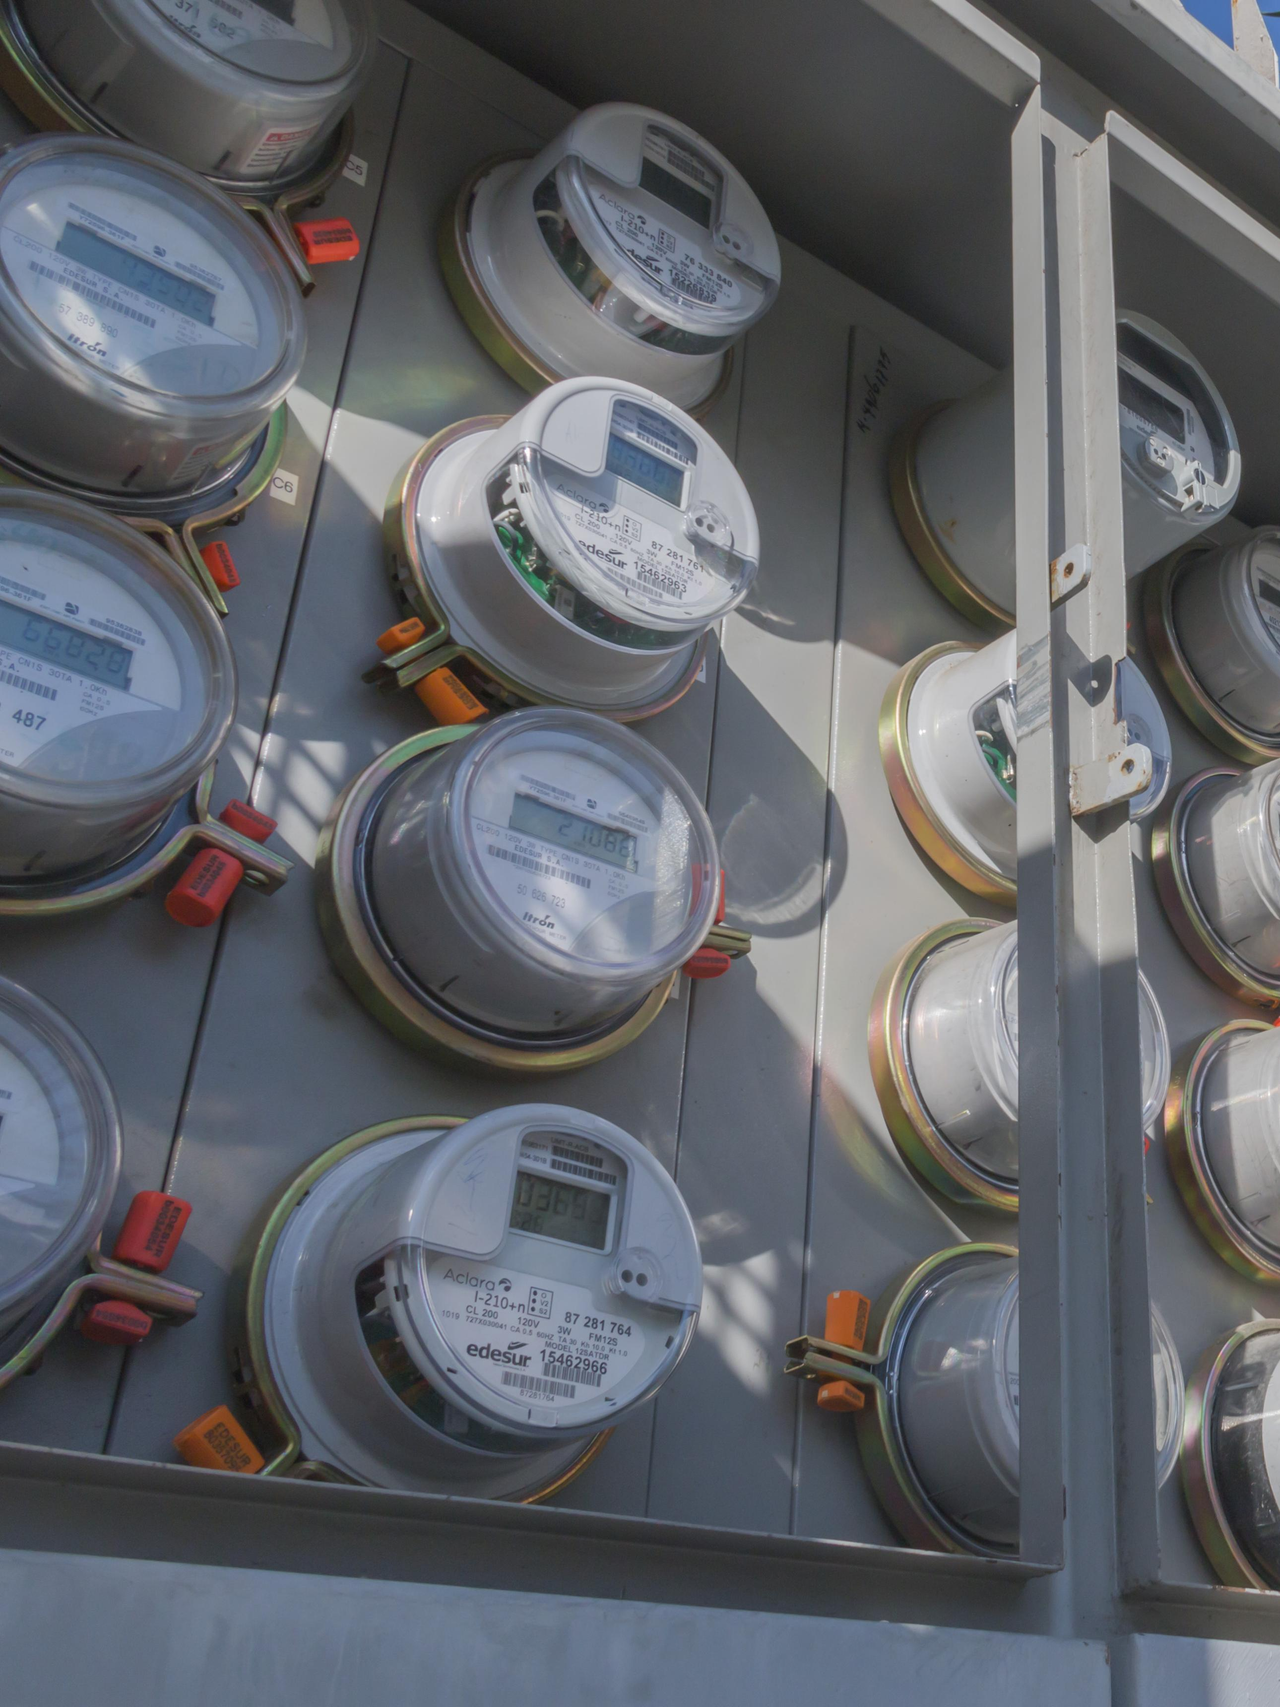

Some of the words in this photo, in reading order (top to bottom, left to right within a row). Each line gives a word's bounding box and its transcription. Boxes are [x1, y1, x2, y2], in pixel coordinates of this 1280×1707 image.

[345, 160, 363, 176] C5
[599, 193, 636, 221] Aclara
[63, 267, 98, 288] EDESUR
[684, 253, 696, 266] 76
[697, 261, 714, 277] 333
[716, 272, 733, 288] 840
[58, 303, 72, 316] 57
[76, 312, 96, 328] 389
[99, 322, 119, 339] 890
[272, 476, 294, 494] C6
[556, 483, 597, 510] Aclara
[574, 512, 585, 524] CL
[587, 518, 601, 531] 200
[615, 533, 633, 547] 120V
[581, 505, 621, 532] I-210+n
[578, 539, 628, 570] edesur
[651, 540, 664, 553] 87
[666, 548, 684, 563] 281
[687, 558, 705, 573] 761
[633, 561, 688, 594] 15462963
[18, 656, 43, 672] CN1S
[48, 667, 73, 684] 30TA
[12, 708, 46, 731] 487
[476, 822, 500, 838] CL200
[505, 831, 523, 846] 120V
[540, 843, 559, 858] TYPE
[514, 843, 543, 860] EDESUR
[547, 855, 564, 868] S.A.
[516, 882, 528, 897] 50
[531, 888, 547, 904] 626
[551, 894, 566, 910] 723
[153, 1206, 183, 1258] EDESUR
[443, 1268, 496, 1292] Aclara
[474, 1290, 526, 1314] I-210+n
[442, 1309, 460, 1321] 1019
[510, 1326, 520, 1334] CA
[522, 1328, 533, 1336] 0.5
[536, 1331, 554, 1341] 60HZ
[592, 1343, 606, 1352] 10.0
[465, 1305, 479, 1316] CL
[481, 1308, 499, 1320] 200
[517, 1316, 540, 1329] 120V
[557, 1325, 572, 1336] 3W
[589, 1332, 618, 1346] FM12S
[564, 1311, 580, 1325] 87
[583, 1316, 605, 1331] 281
[610, 1321, 632, 1337] 764
[466, 1342, 532, 1368] edesur
[540, 1349, 608, 1375] 15462966
[544, 1340, 573, 1353] MODEL
[575, 1347, 610, 1361] 12SATDR
[520, 1388, 555, 1402] 87281764
[213, 1421, 252, 1469] EDESUR
